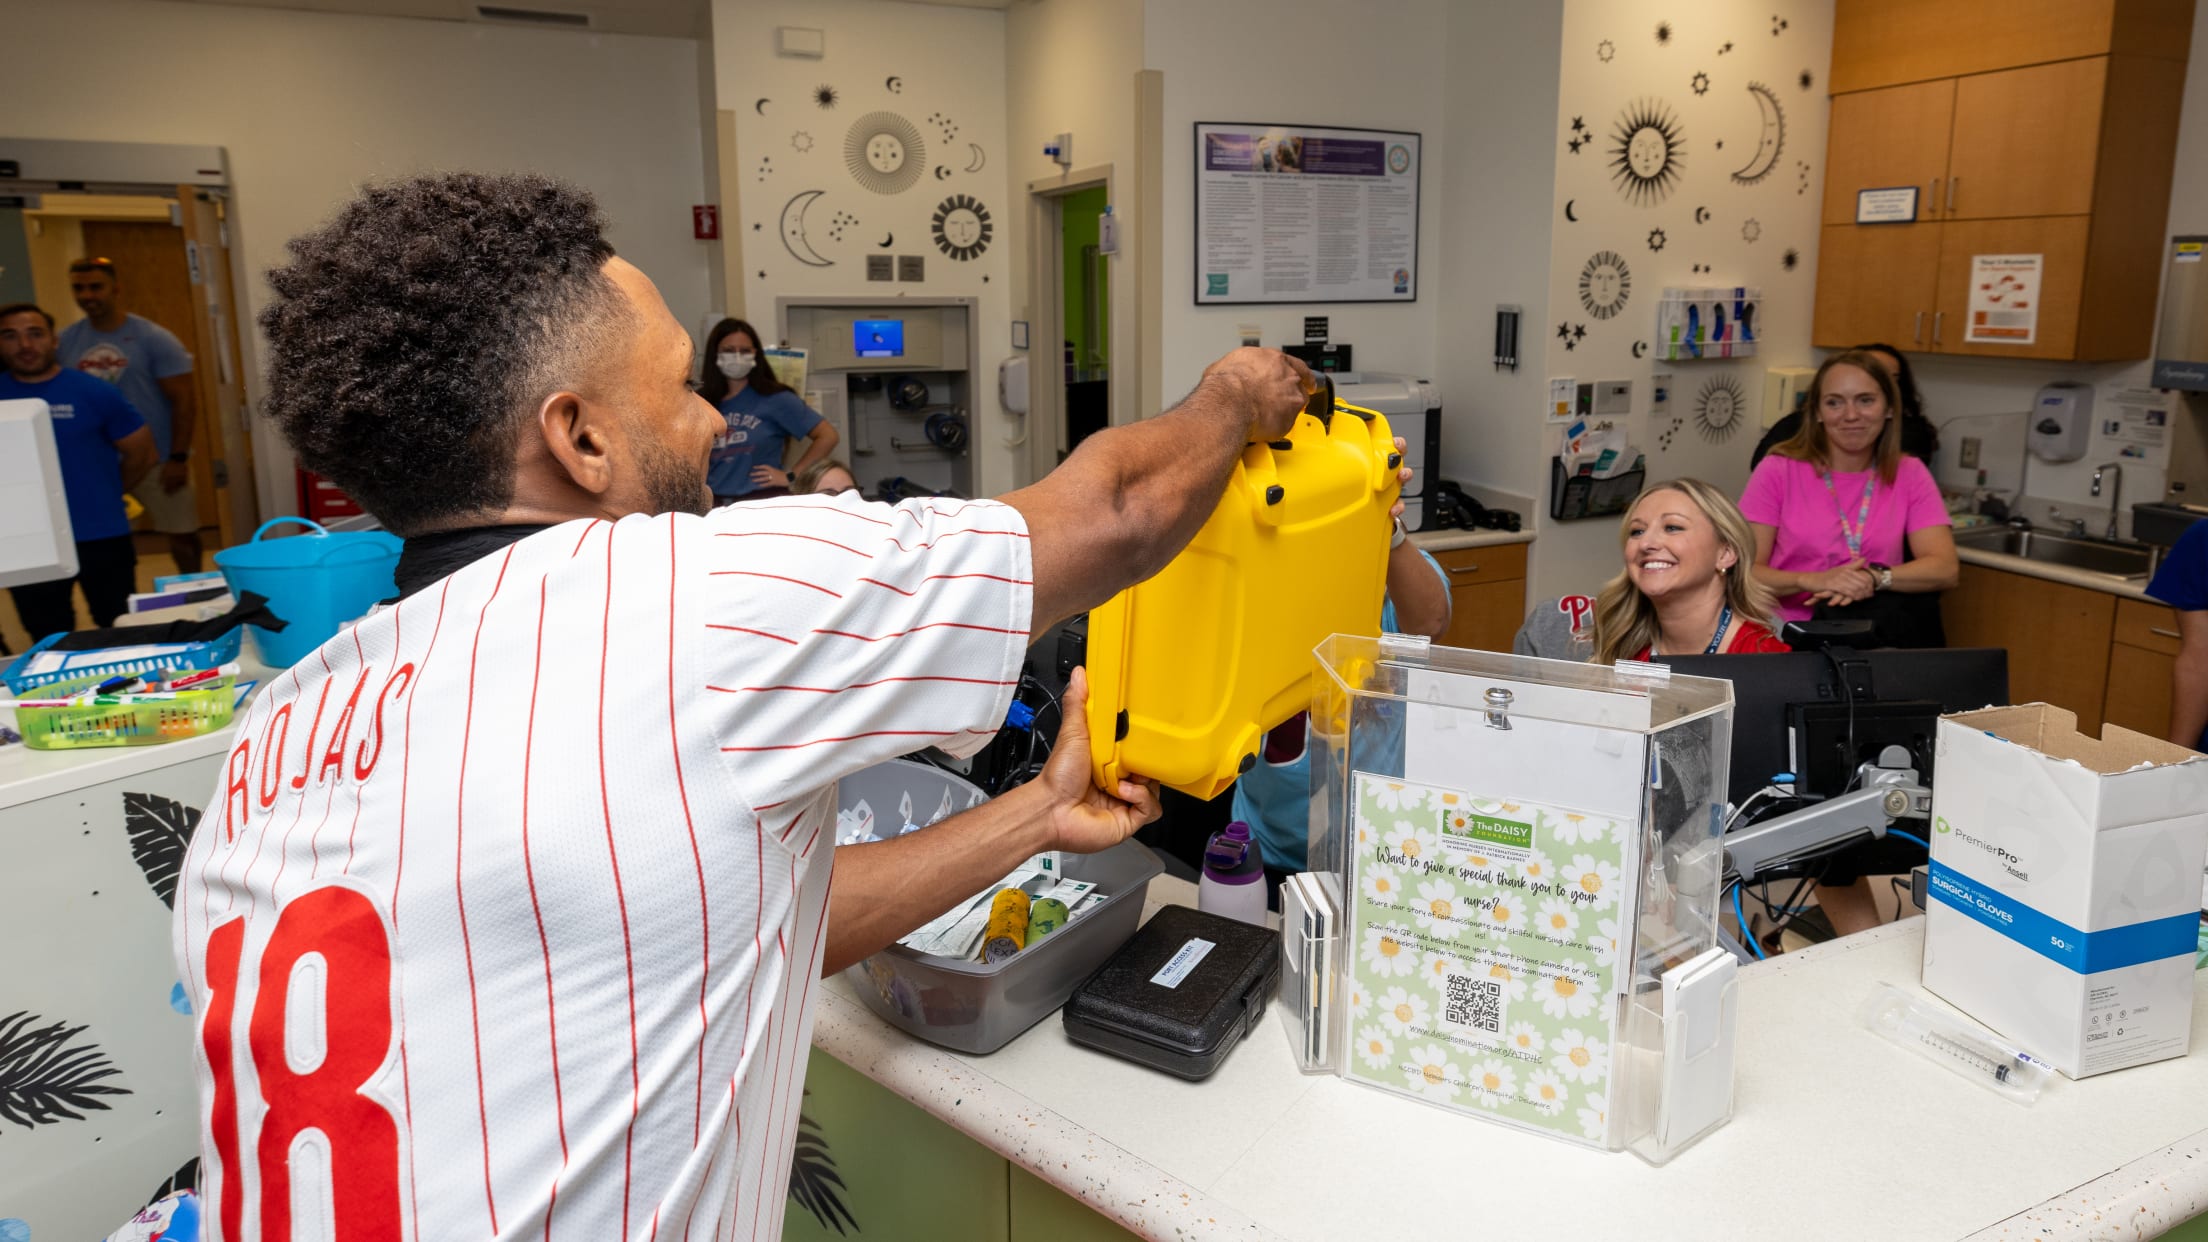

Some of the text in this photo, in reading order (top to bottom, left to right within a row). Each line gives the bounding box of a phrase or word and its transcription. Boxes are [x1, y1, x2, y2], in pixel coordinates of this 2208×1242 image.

[226, 662, 416, 846] ROJAS
[1452, 845, 1473, 853] MEMORY
[1486, 851, 1505, 860] PATRICK
[1477, 821, 1528, 837] The DAISY
[1376, 846, 1598, 904] Want to give a special thank you to your
[2007, 865, 2028, 880] Ansell
[1464, 896, 1500, 913] nurse?
[1932, 876, 2014, 923] SURGICAL GLOVES
[1366, 898, 1388, 908] Share
[1390, 903, 1405, 911] your
[1407, 906, 1426, 917] story
[1437, 912, 1491, 930] compassionate
[1508, 928, 1533, 939] skillful
[1535, 935, 1564, 946] nursing
[1565, 940, 1582, 949] care
[1584, 944, 1604, 954] with
[1367, 921, 1383, 930] Scan
[1385, 926, 1398, 934] the
[1400, 928, 1412, 938] QR
[1413, 932, 1428, 940] code
[1430, 935, 1451, 946] below
[1453, 940, 1470, 950] from
[1472, 946, 1488, 954] your
[1490, 949, 1514, 959] smart
[1516, 955, 1539, 965] phone
[1541, 960, 1570, 972] camera
[1582, 969, 1600, 978] visit
[2050, 935, 2065, 949] 50
[1161, 965, 1174, 976] PORT
[1172, 951, 1188, 967] ACCESS
[1381, 936, 1394, 944] the
[1395, 938, 1424, 950] website
[1425, 946, 1445, 956] below
[1458, 954, 1481, 964] access
[1483, 959, 1497, 967] the
[1498, 962, 1520, 973] online
[1521, 968, 1563, 982] nomination
[1565, 975, 1584, 987] form
[202, 885, 404, 1242] 18
